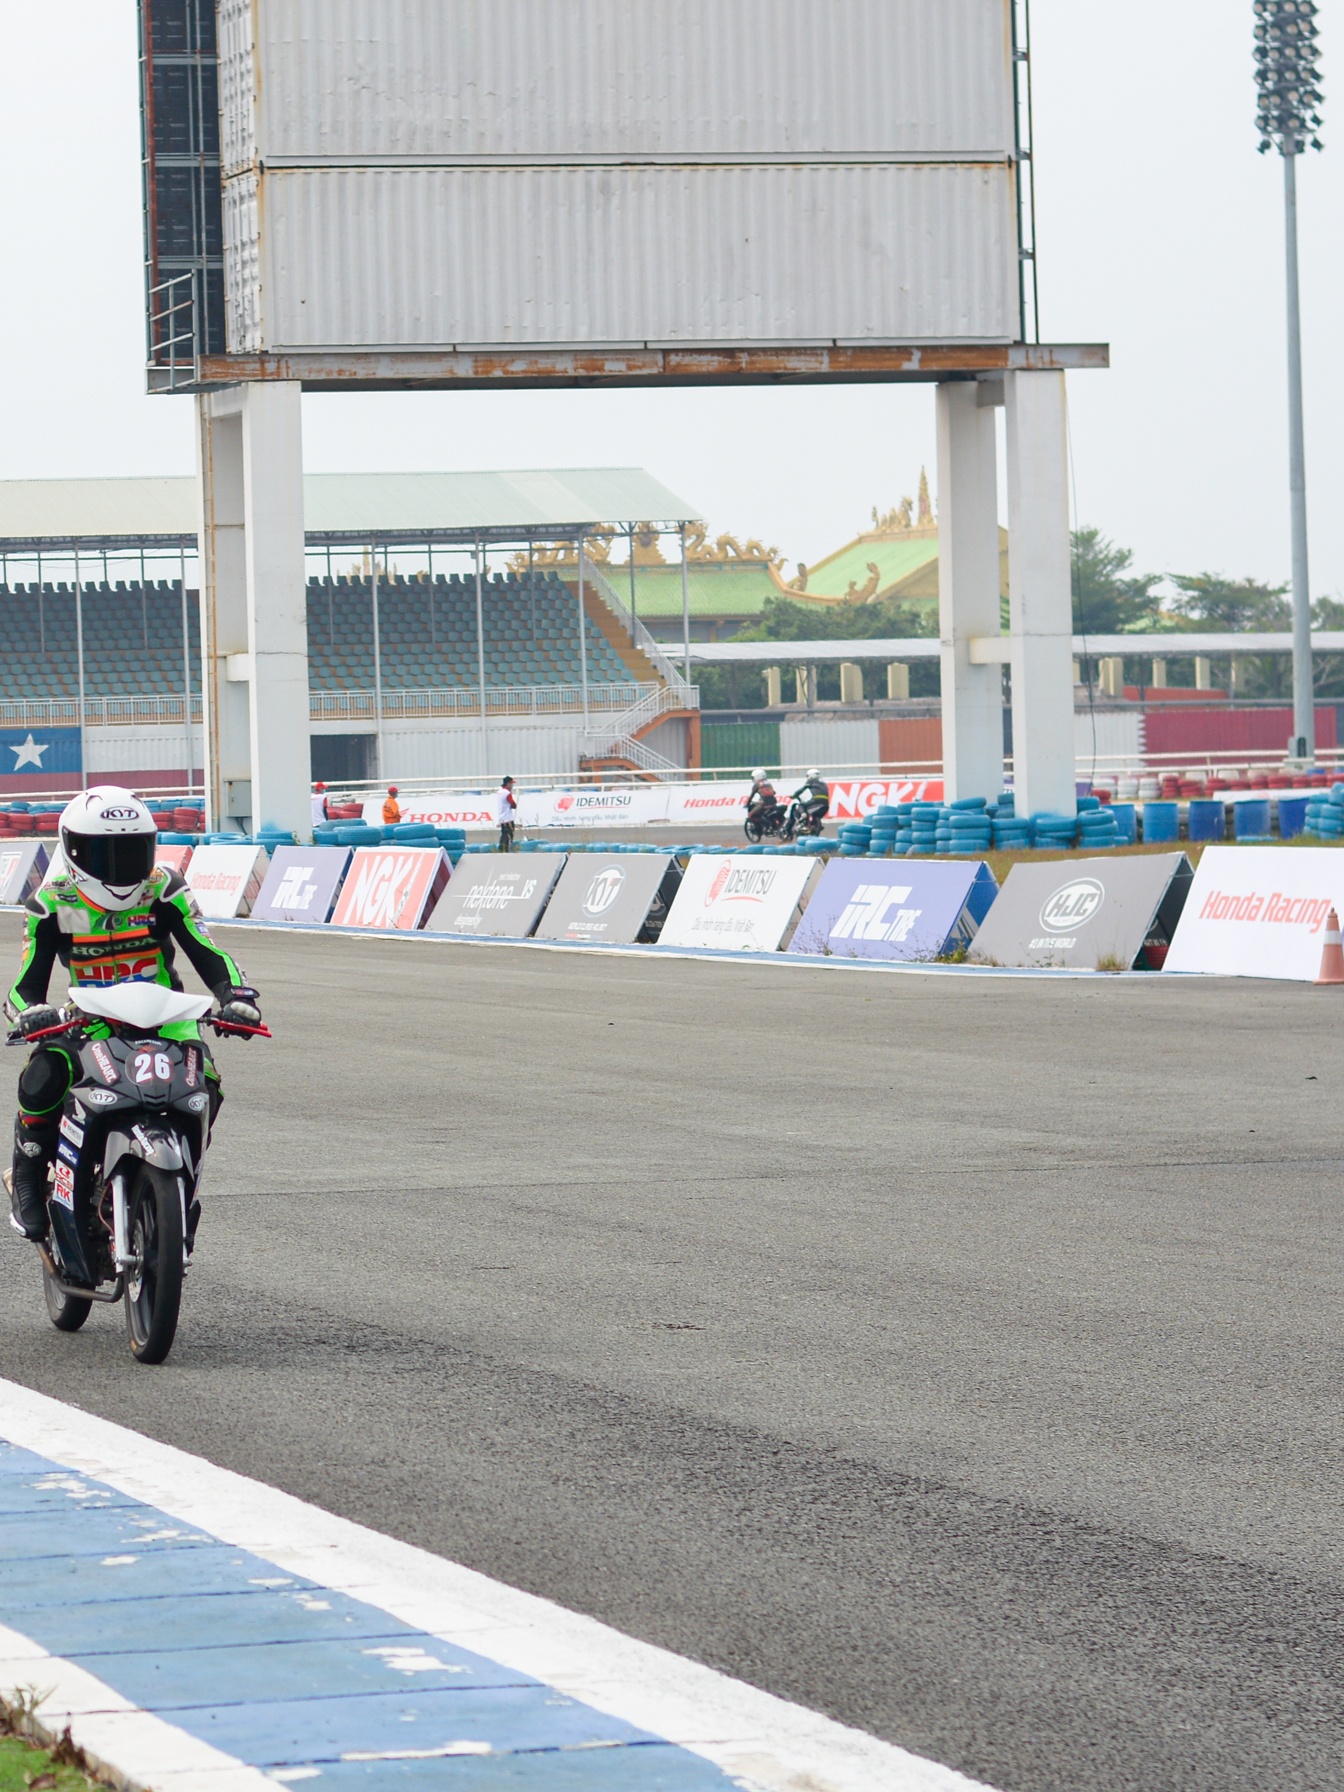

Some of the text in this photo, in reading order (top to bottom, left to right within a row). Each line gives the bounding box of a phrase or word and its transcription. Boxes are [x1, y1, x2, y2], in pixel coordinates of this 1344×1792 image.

[576, 795, 632, 807] IDEMITSU
[683, 797, 736, 808] Honda
[828, 783, 914, 818] NGK
[104, 809, 135, 819] KYT
[409, 811, 493, 823] HONDA
[190, 872, 242, 896] Honda Racing
[342, 854, 414, 928] NGK
[585, 877, 623, 906] KYT
[724, 869, 777, 894] IDEMITSU
[462, 880, 515, 909] nextone
[1046, 893, 1099, 918] HJC
[1199, 890, 1332, 934] Honda Racing
[883, 909, 922, 941] TIRE
[72, 937, 157, 956] HONDA
[134, 1053, 171, 1083] 26
[56, 1183, 71, 1202] RK
